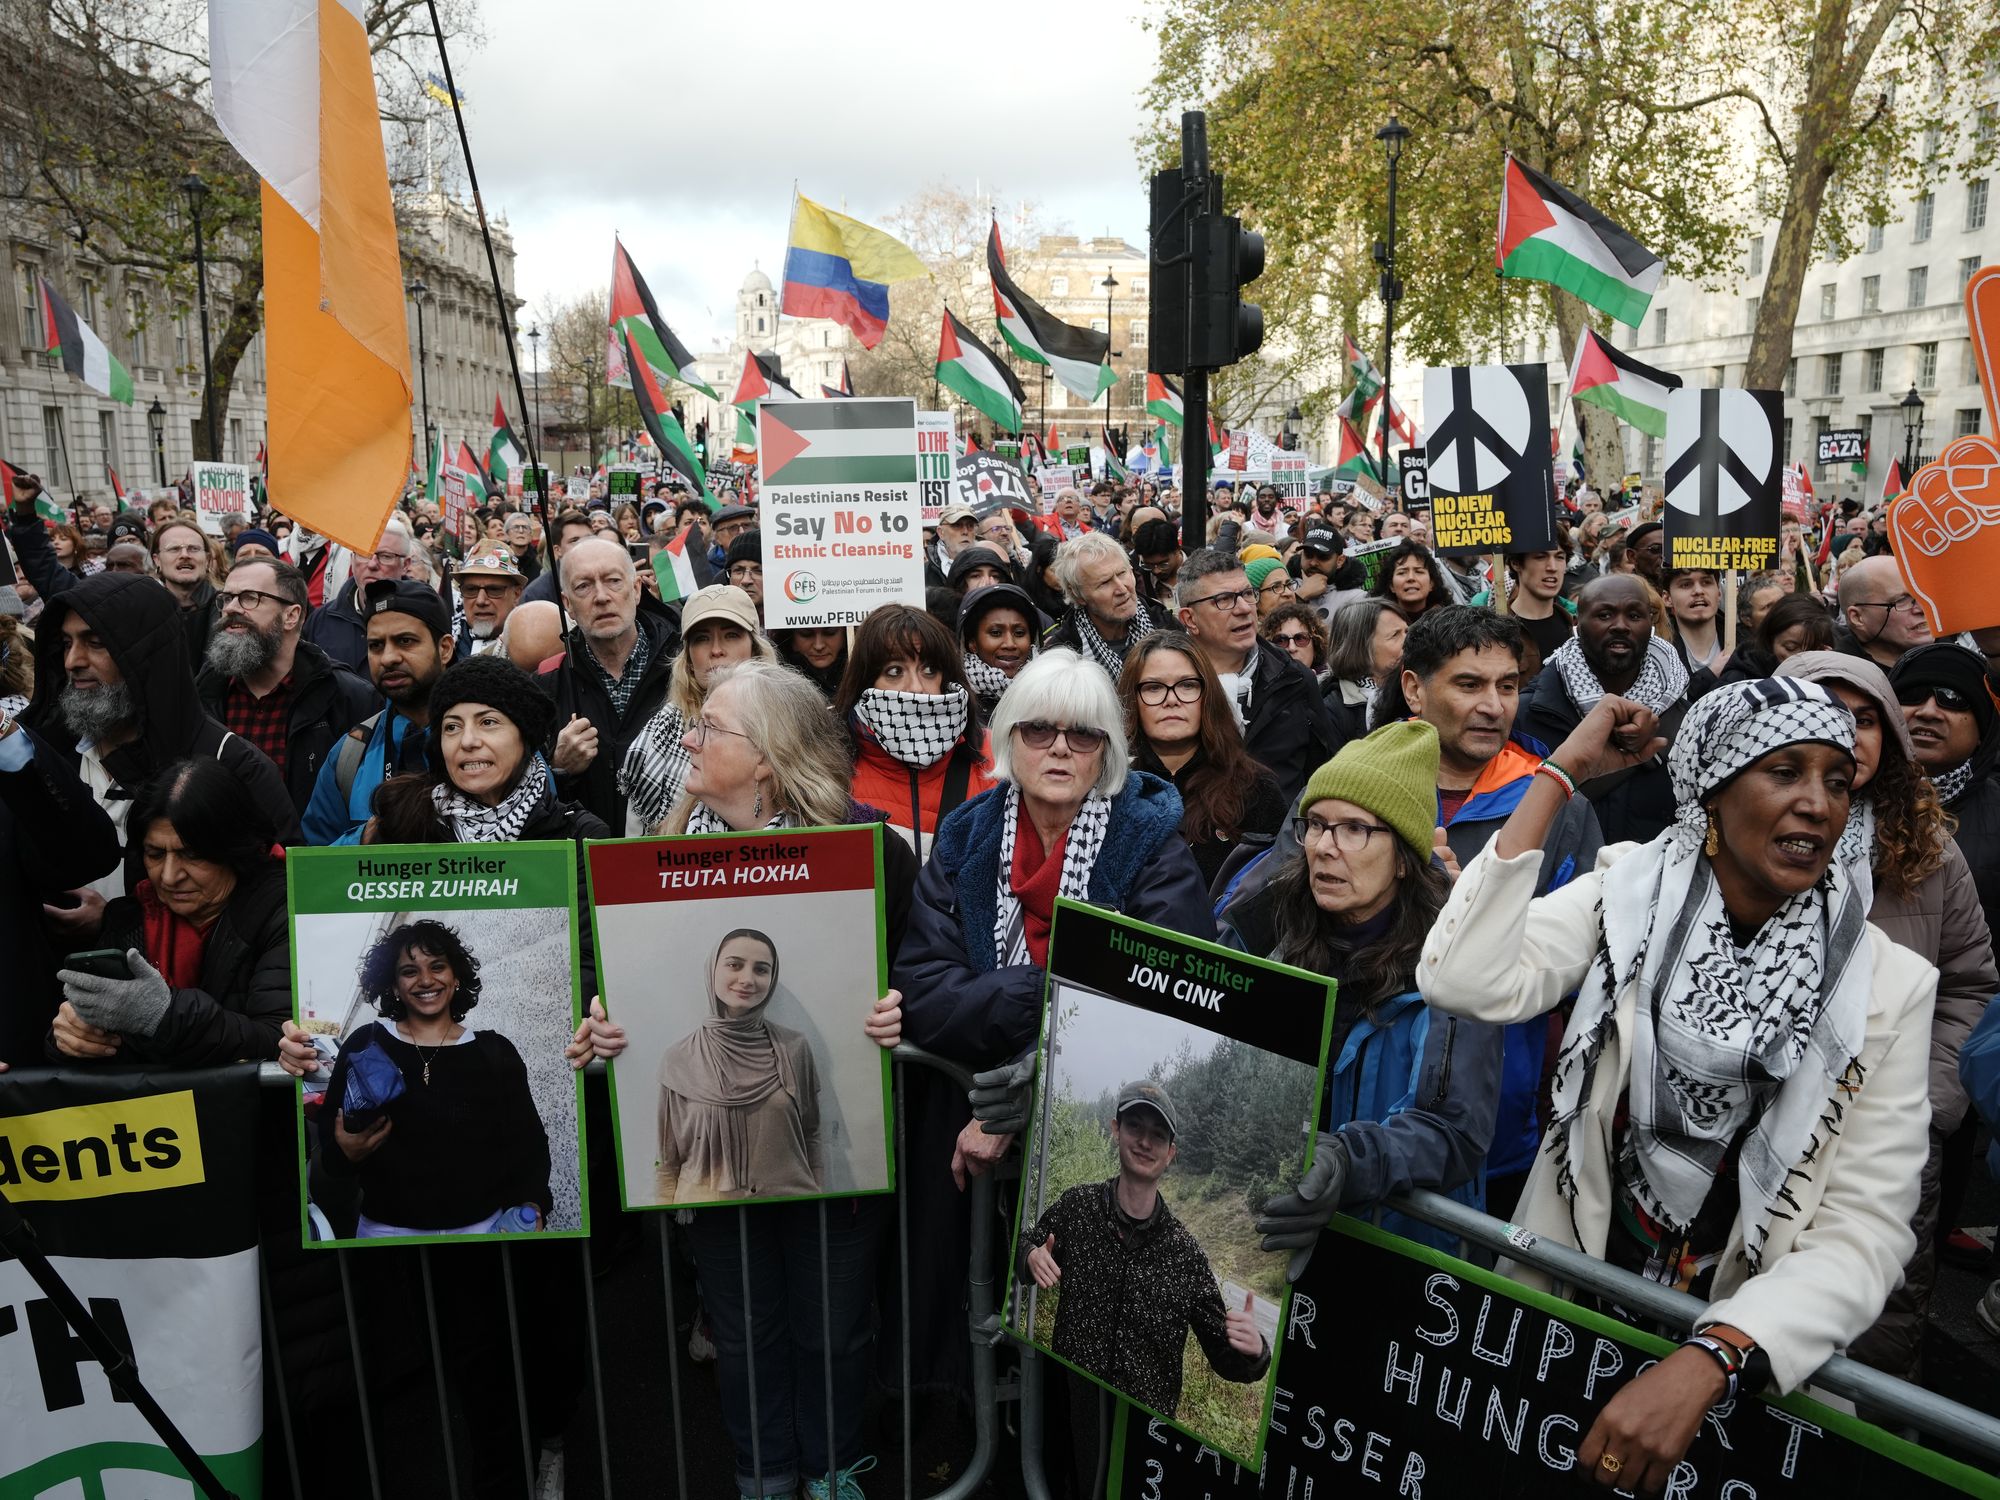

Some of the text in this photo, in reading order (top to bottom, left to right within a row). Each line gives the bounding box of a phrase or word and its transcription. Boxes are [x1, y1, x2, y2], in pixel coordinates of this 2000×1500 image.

[918, 432, 949, 452] D THE
[1834, 432, 1862, 441] Starving
[1819, 440, 1862, 459] GAZA
[920, 454, 950, 479] T TO
[978, 457, 1021, 477] Starving
[1272, 471, 1305, 482] DEFEND THE
[199, 471, 246, 492] END THE
[957, 470, 1032, 506] GAZA
[1296, 483, 1306, 497] TO
[200, 488, 247, 513] GENOCIDE
[771, 490, 908, 504] Palestinians Resist
[1433, 497, 1456, 514] NO
[1458, 495, 1493, 513] NEW
[775, 511, 909, 541] Say No to
[1434, 511, 1506, 530] NUCLEAR
[1435, 527, 1512, 548] WEAPONS
[1672, 537, 1777, 554] NUCLEAR-FREE
[774, 541, 913, 559] Ethnic Cleansing
[1354, 543, 1377, 555] Socialist
[1375, 541, 1393, 551] Worker
[1672, 554, 1768, 570] MIDDLE EAST
[794, 578, 816, 595] PFB
[821, 587, 855, 595] Palestinian
[785, 610, 871, 626] www.PFBU
[657, 842, 808, 868] Hunger Striker
[357, 856, 506, 880] Hunger Striker
[658, 863, 810, 889] TEUTA HOXHA
[347, 878, 518, 902] QESSER ZUHRAH
[1109, 928, 1255, 993] Hunger Striker
[1127, 963, 1226, 1013] JON CINK
[0, 1123, 182, 1185] dents
[1288, 1292, 1317, 1349] R
[1416, 1273, 1824, 1479] SUPPRT
[1270, 1385, 1427, 1500] ESSER
